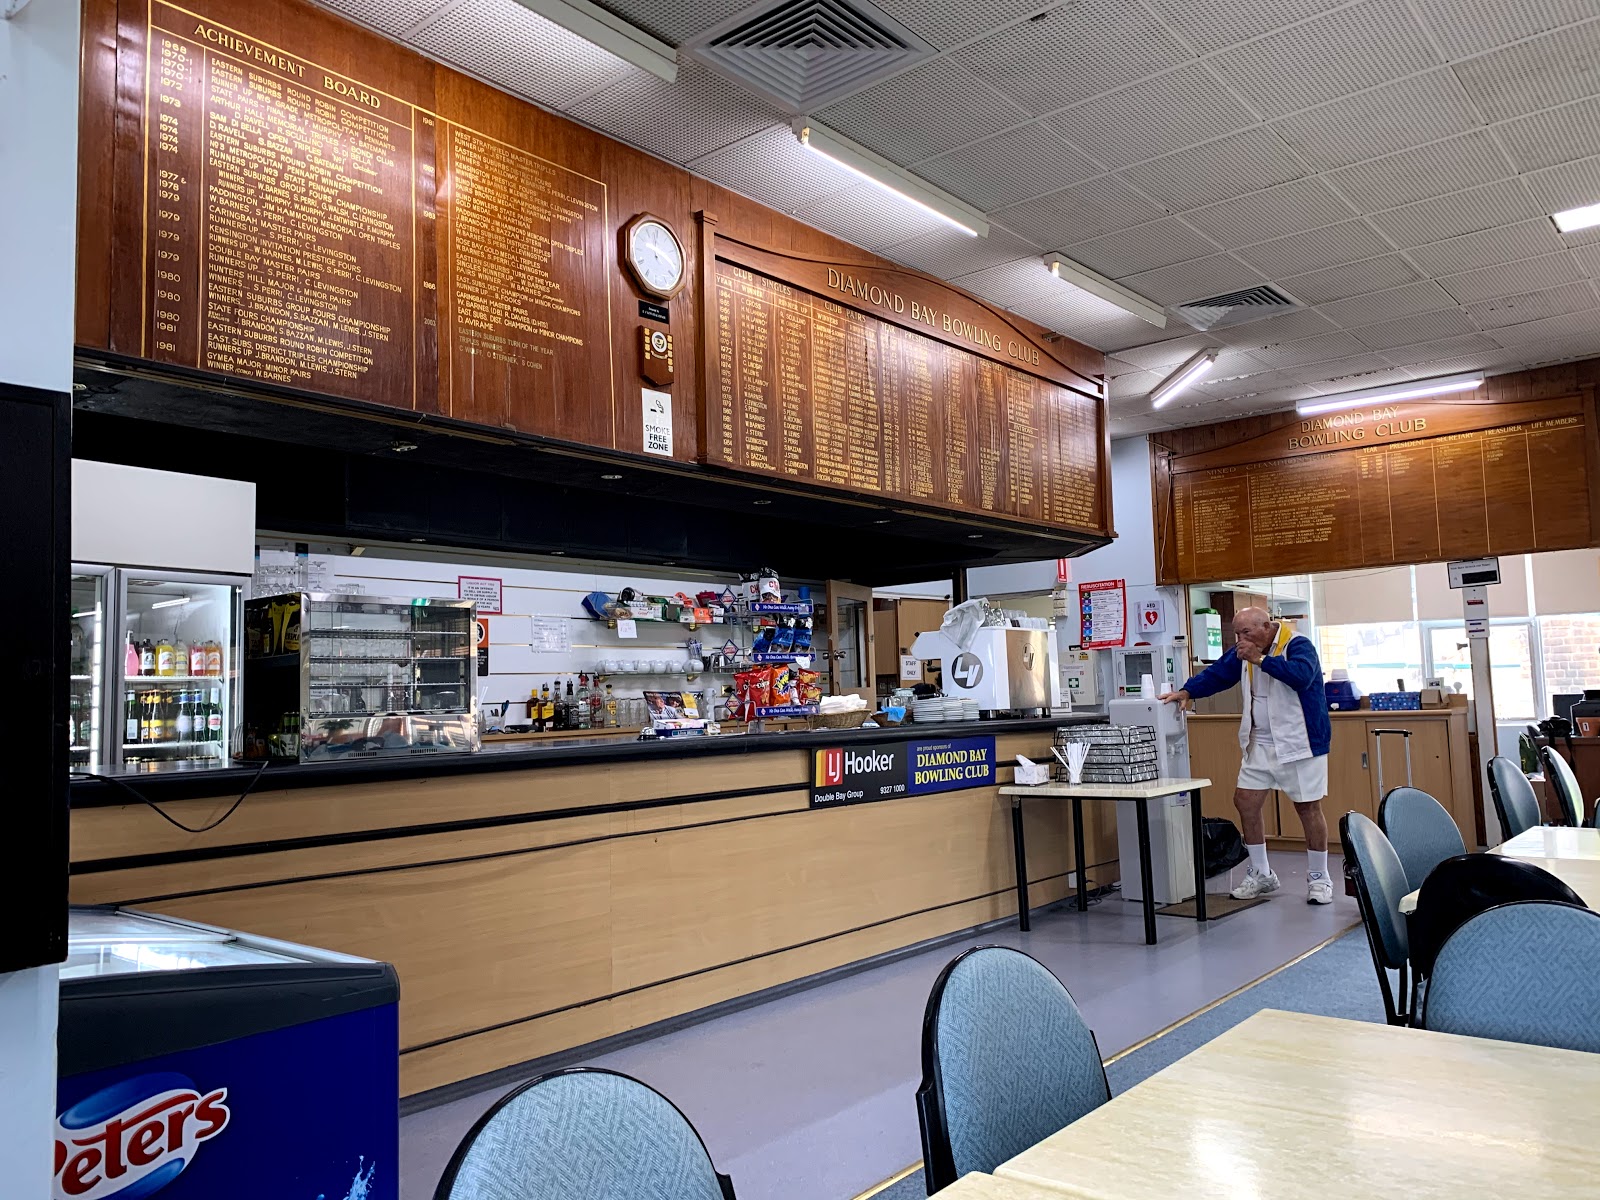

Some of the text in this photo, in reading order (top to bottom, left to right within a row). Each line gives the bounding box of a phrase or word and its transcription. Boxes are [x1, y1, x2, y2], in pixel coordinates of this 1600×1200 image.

[161, 38, 186, 54] 1968
[161, 47, 192, 65] 1970-1
[194, 21, 380, 110] ACHIEVEMENT BOARD
[160, 76, 182, 91] 1972
[160, 93, 180, 108] 1973
[211, 58, 388, 133] EASTERN SUBURBS ROUND ROBIN COMPETITION
[160, 113, 178, 126] 1974
[423, 117, 434, 127] 1981
[210, 93, 393, 167] ARTHUR HALL MEMORIAL TRIPLES BONDI CLUB
[159, 169, 178, 181] 1977
[159, 178, 178, 191] 1978
[209, 157, 387, 221] EASTERN SUBURBS GROUP FOURS CHAMPIONSHIP
[159, 189, 179, 201] 1979
[209, 185, 400, 250] PADDINGTON JIM HAMMOND MEMORIAL OPEN TRIPLES
[158, 229, 179, 241] 1979
[209, 224, 361, 273] KENSINGTON INVITATION PRESTIGE FOURS
[209, 243, 320, 279] DOUBLE BAY MASTER PAIRS
[157, 270, 180, 282] 1980
[456, 252, 481, 266] EASTERN
[483, 261, 509, 274] SUBURBS
[512, 270, 525, 279] TURN
[534, 276, 544, 285] THE
[544, 279, 559, 290] YEAR
[208, 263, 244, 278] HUNTERS
[247, 273, 264, 284] HILL
[268, 278, 294, 291] MAJOR
[304, 288, 326, 300] MINOR
[330, 294, 351, 306] PAIRS
[716, 276, 732, 287] YEAR
[734, 267, 791, 295] CLUB SINGLES
[457, 290, 528, 316] CARINGBAH MASTER PAIRS
[779, 299, 807, 314] RUNNER UP
[825, 303, 866, 322] CLUB PAIRS
[827, 268, 1039, 366] DIAMOND BAY BOWLING CLUB
[156, 321, 176, 332] 1981
[504, 319, 532, 332] CHAMPION
[539, 329, 554, 338] MINOR
[556, 333, 583, 346] CHAMPIONS
[156, 341, 175, 351] 1981
[207, 351, 234, 363] GYMEA
[290, 368, 311, 379] PAIRS
[256, 343, 286, 356] DISTRICT
[288, 350, 315, 362] TRIPLES
[318, 356, 368, 373] CHAMPIONSHIP
[1301, 406, 1399, 433] DIAMOND BAY
[1546, 417, 1577, 427] MEMBERS
[646, 425, 670, 435] SMOKE
[1288, 418, 1426, 449] BOWLING CLUB
[1436, 432, 1474, 442] SECRETARY
[1485, 425, 1522, 435] TREASURER
[648, 441, 668, 451] ZONE
[650, 434, 667, 443] FREE
[1390, 440, 1425, 449] PRESIDENT
[1081, 582, 1114, 590] RESUSCITATION
[917, 749, 987, 767] DIAMOND BAY
[829, 750, 894, 782] LJ Hooker
[915, 765, 989, 785] BOWLING CLUB
[815, 790, 863, 802] Double Bay Group
[880, 784, 905, 794] 9327 1000
